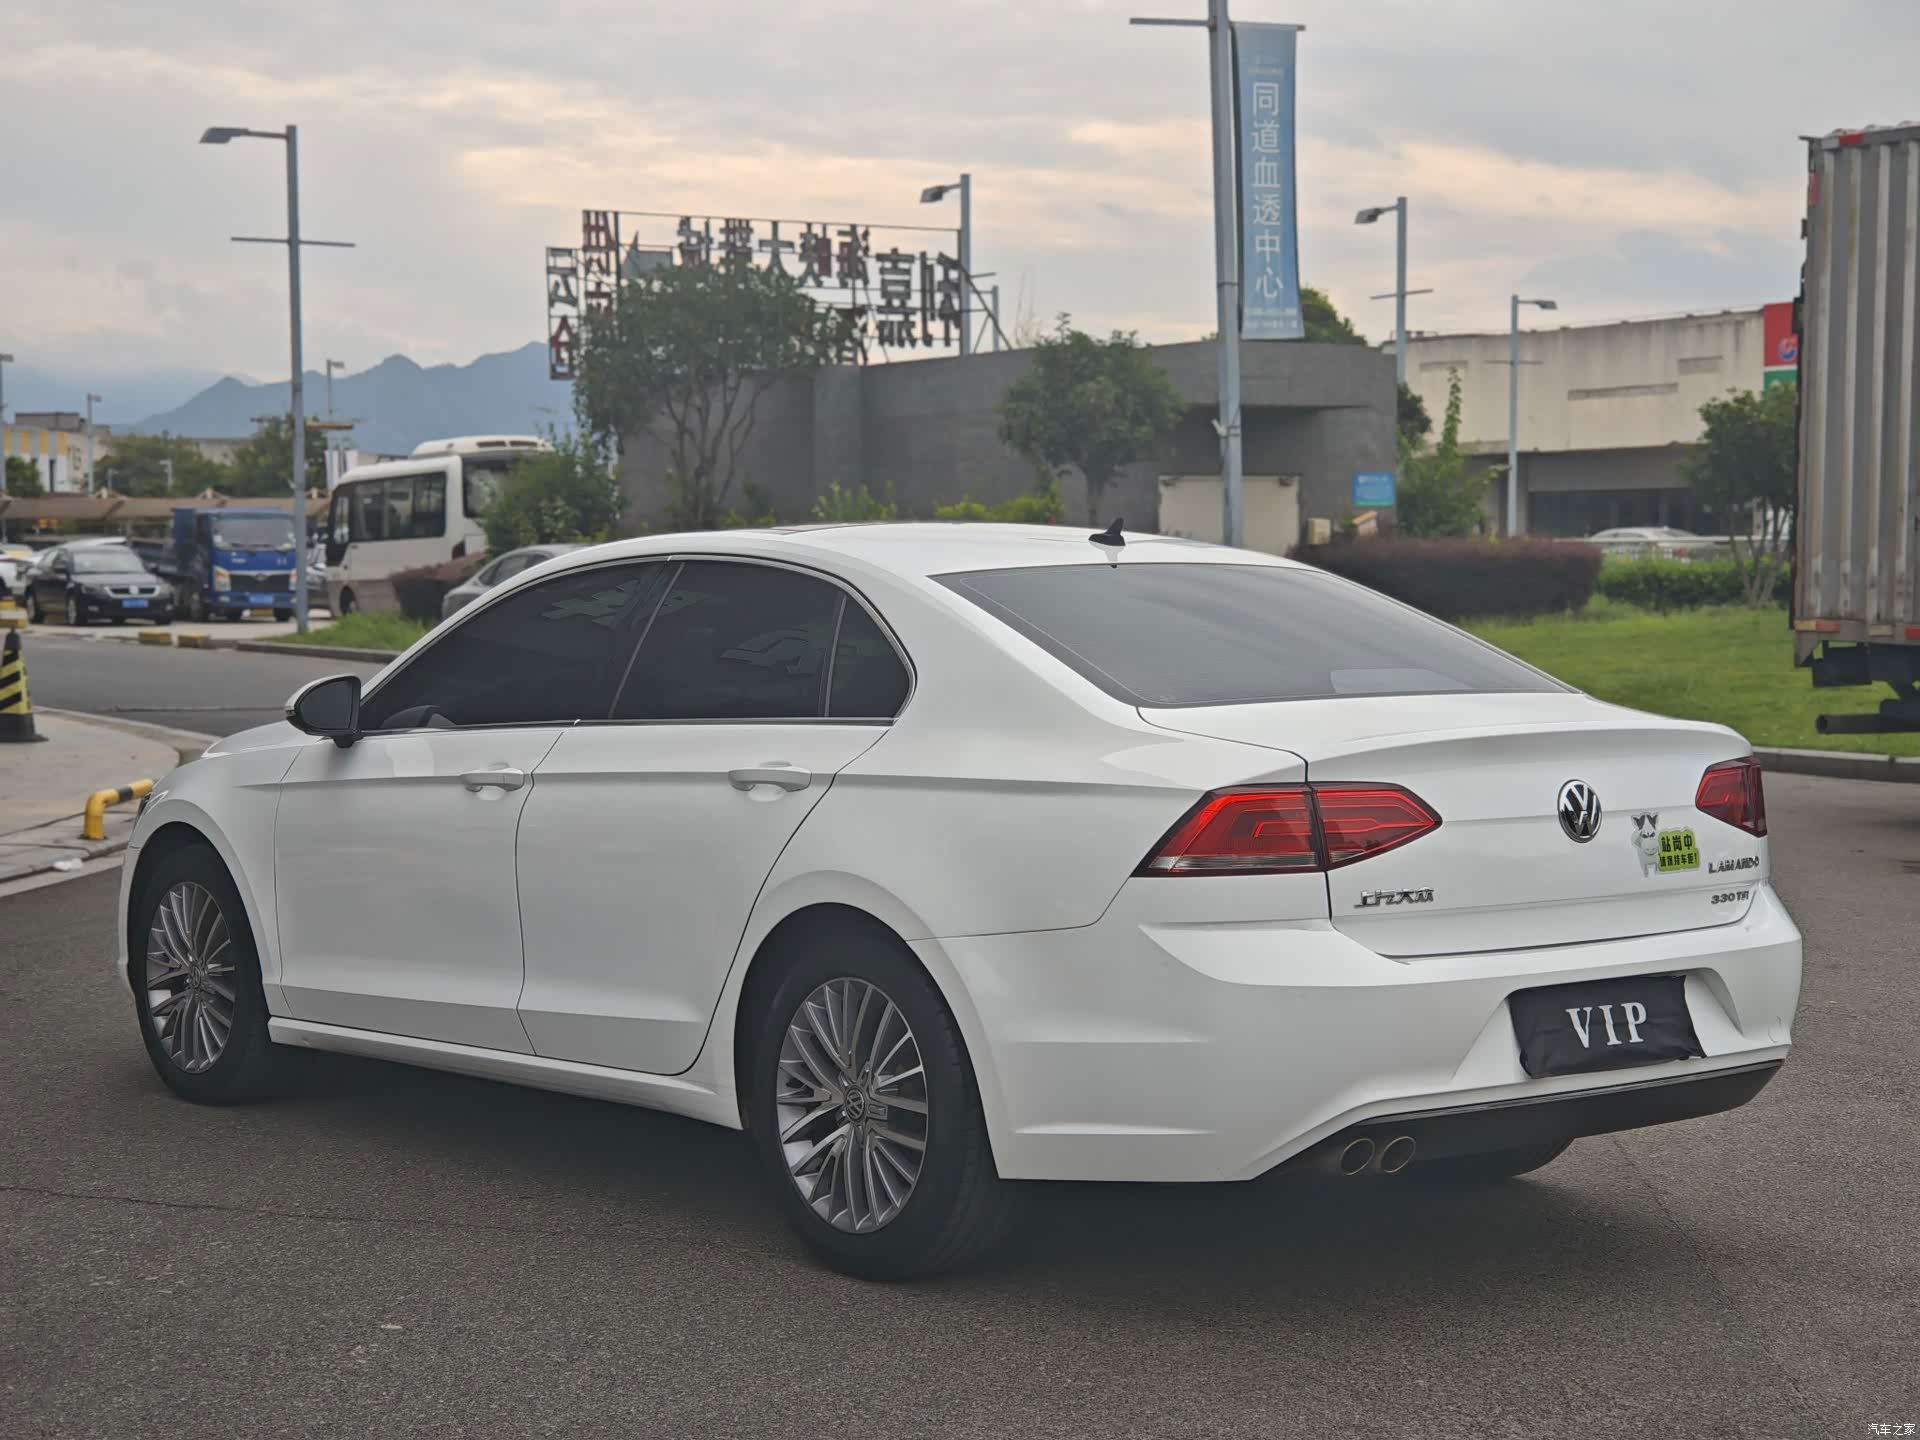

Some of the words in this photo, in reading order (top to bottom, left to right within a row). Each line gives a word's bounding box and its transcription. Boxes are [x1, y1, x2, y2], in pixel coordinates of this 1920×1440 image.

[1252, 82, 1283, 298] 同道血透中心
[1660, 834, 1693, 852] 站岗中
[1708, 856, 1760, 874] LAMANDO
[1565, 1002, 1648, 1049] VIP
